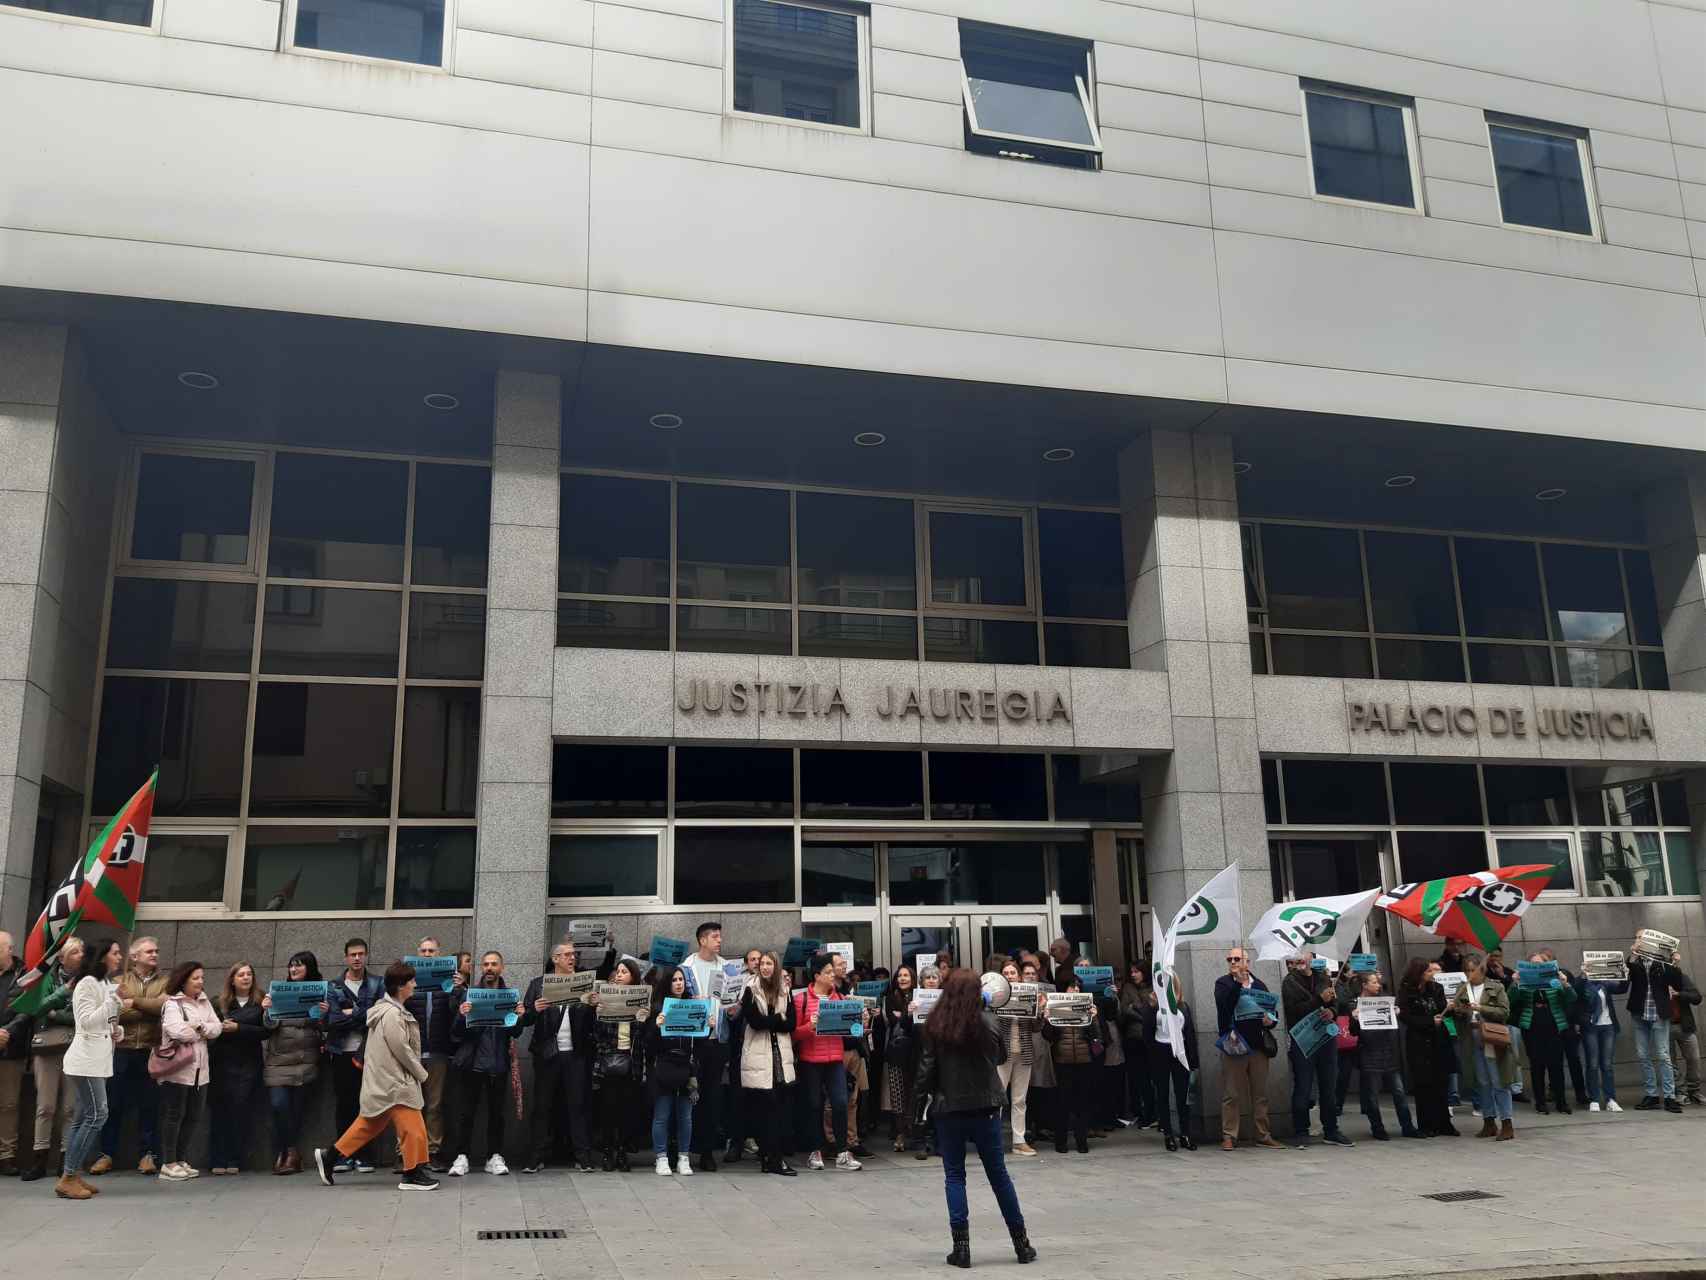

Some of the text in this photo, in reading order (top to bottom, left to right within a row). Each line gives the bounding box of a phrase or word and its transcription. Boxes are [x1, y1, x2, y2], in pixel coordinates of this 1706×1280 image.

[678, 680, 1072, 724] JUSTIZIA JAUREGIA
[1350, 702, 1655, 743] PALACIO DE JUSTICIA
